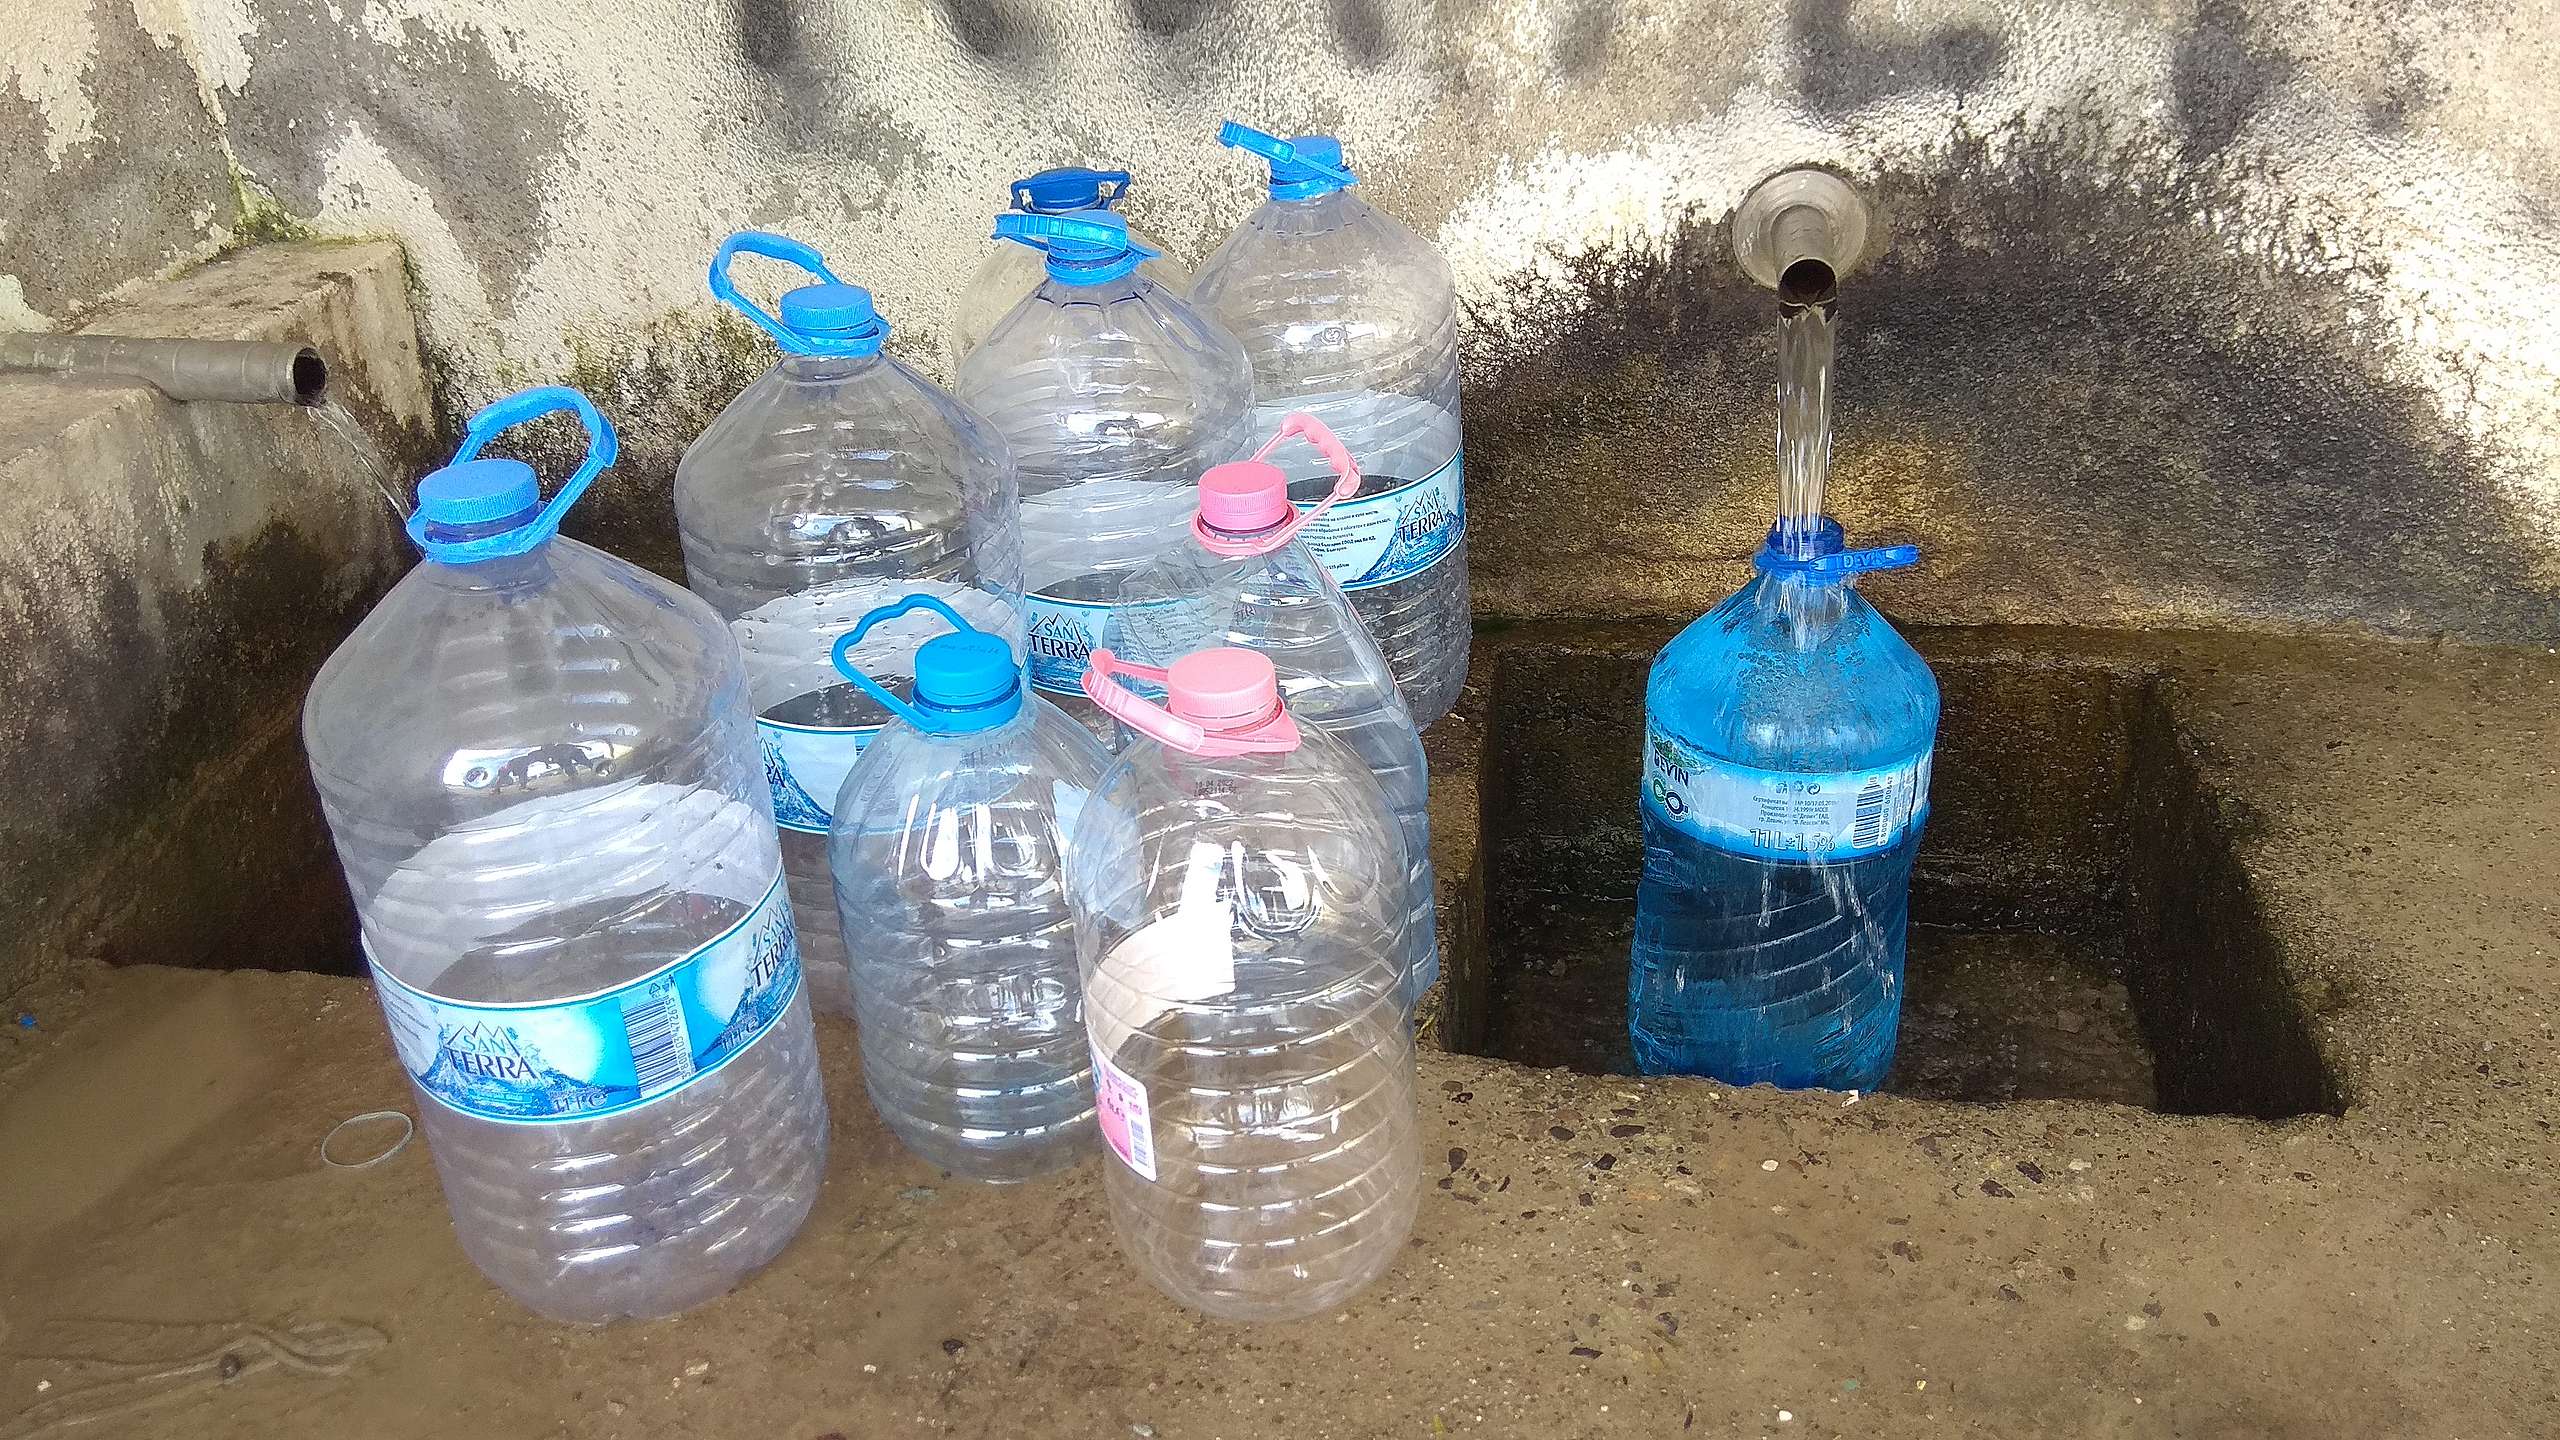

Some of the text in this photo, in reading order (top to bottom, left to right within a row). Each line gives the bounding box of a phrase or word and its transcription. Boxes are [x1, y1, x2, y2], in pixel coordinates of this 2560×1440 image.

[1398, 507, 1444, 543] TERRA
[1028, 632, 1091, 661] TERRA
[1044, 622, 1074, 641] SAN
[750, 925, 794, 987] TERRA
[463, 1034, 507, 1054] SAN
[443, 1045, 539, 1080] TERRA
